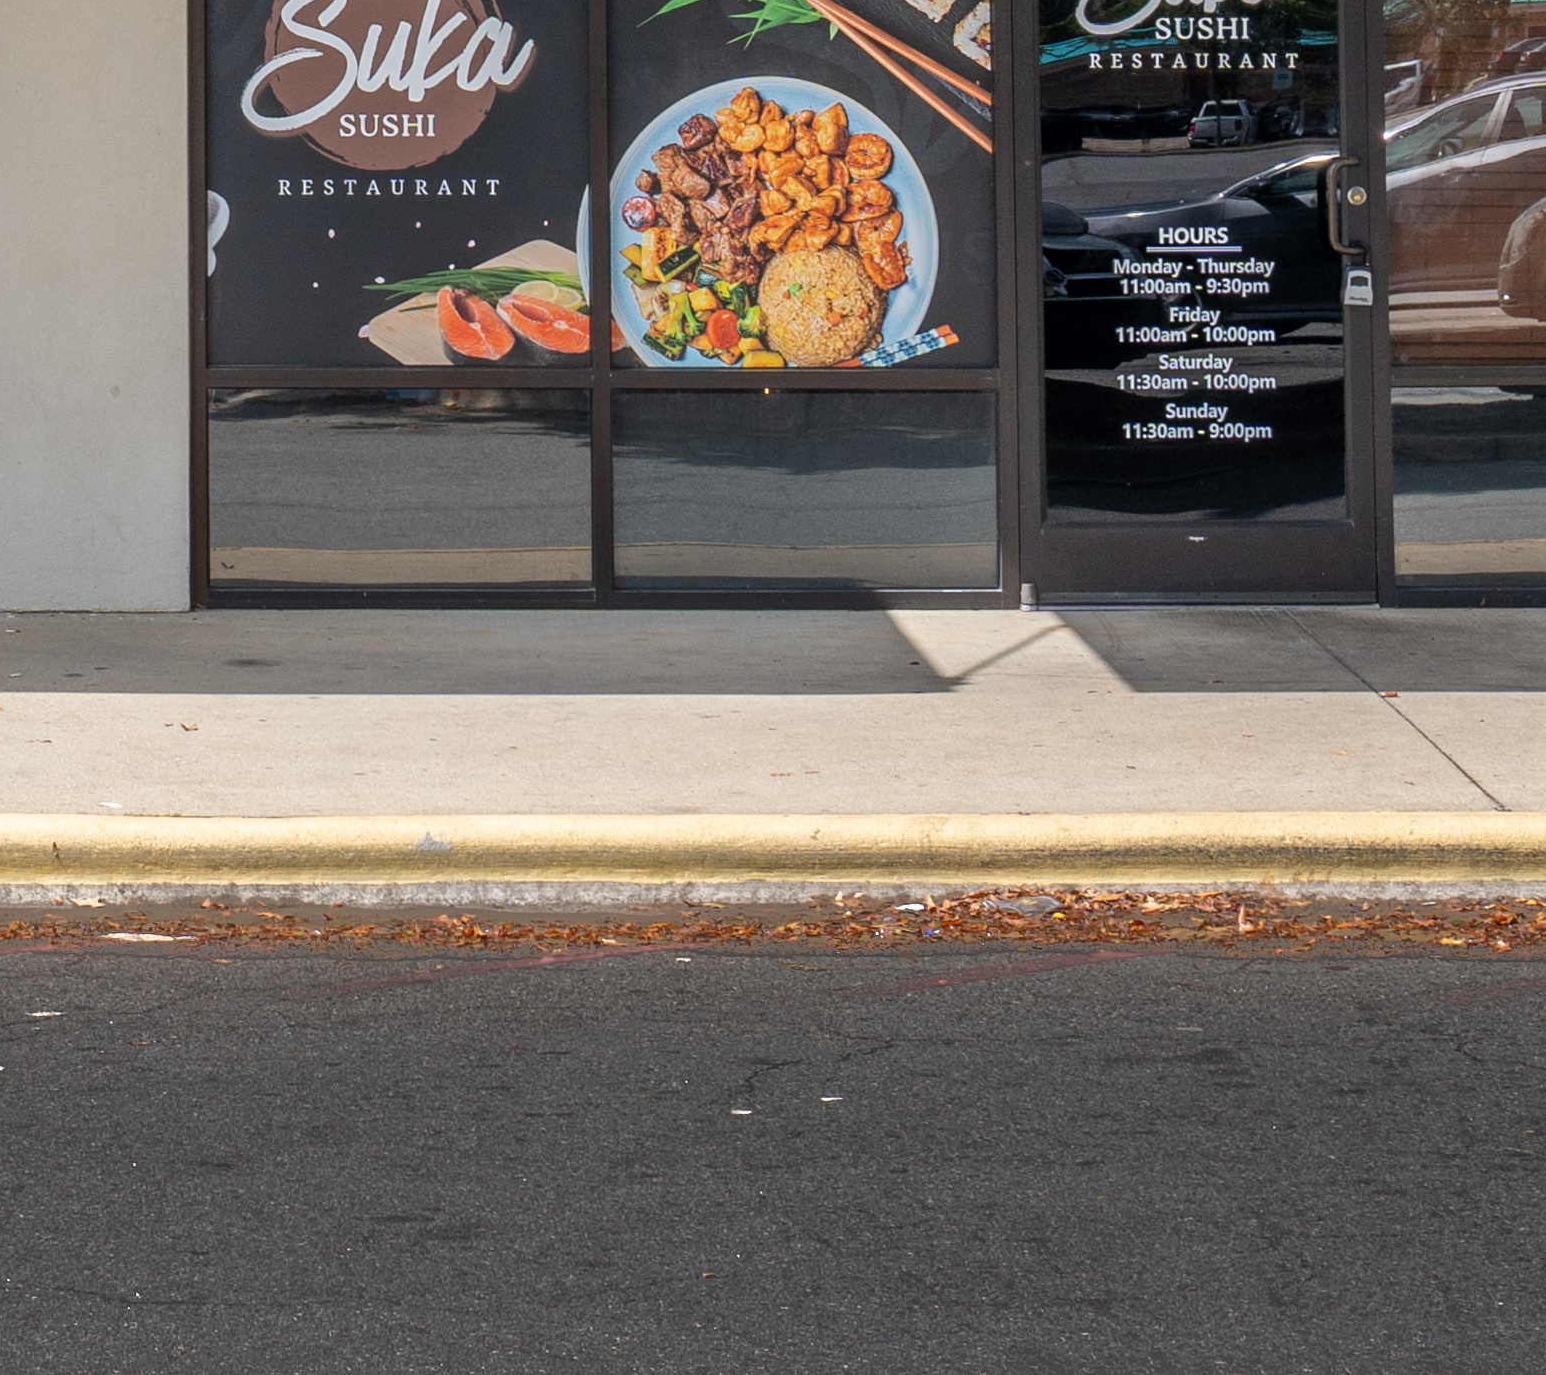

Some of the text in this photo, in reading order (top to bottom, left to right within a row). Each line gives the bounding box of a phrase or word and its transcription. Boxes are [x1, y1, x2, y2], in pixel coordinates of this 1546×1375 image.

[1155, 17, 1250, 40] SUSHI
[1089, 53, 1299, 69] RESTAURANT
[339, 113, 436, 137] SUSHI
[278, 179, 500, 195] RESTAURANT
[1158, 227, 1229, 245] HOURS
[1113, 258, 1183, 278] Monday
[1197, 257, 1275, 278] Thursday
[1119, 278, 1192, 295] 11:00am
[1206, 278, 1270, 297] 9:30pm
[1169, 306, 1221, 326] Friday
[1115, 327, 1188, 343] 11:00am
[1202, 326, 1276, 346] 10:00pm
[1158, 353, 1233, 373] Saturday
[1116, 374, 1188, 390] 11:30am
[1203, 373, 1277, 393] 10:00pm
[1165, 402, 1229, 422] Sunday
[1122, 423, 1194, 439] 11:30am
[1209, 422, 1273, 442] 9:00pm
